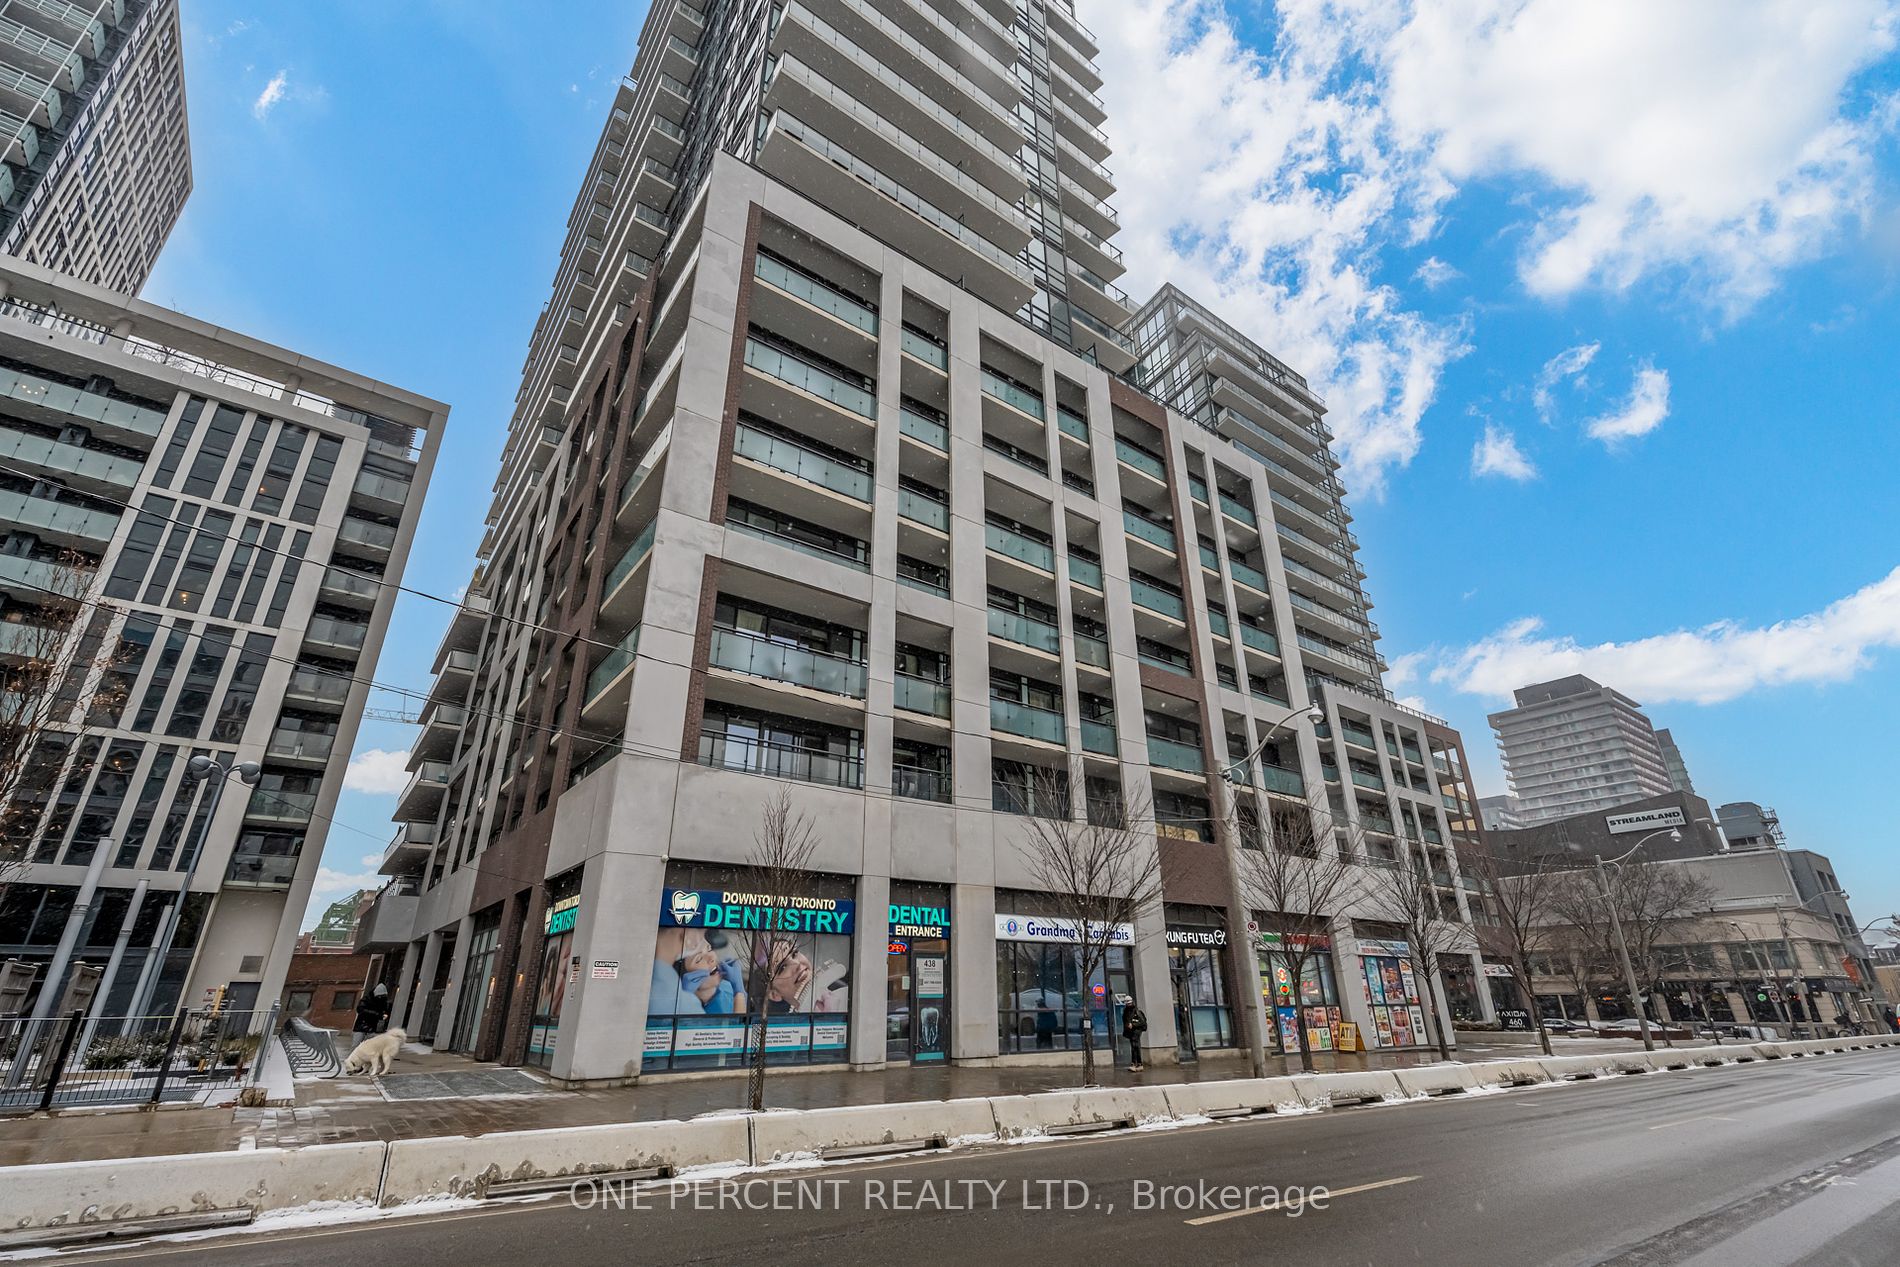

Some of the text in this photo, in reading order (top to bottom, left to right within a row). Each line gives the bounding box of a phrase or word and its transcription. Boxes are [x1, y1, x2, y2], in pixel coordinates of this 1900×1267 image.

[1609, 811, 1680, 826] STREAMLAND
[790, 896, 836, 910] TORONTO
[704, 903, 849, 933] DENTISTRY
[888, 904, 951, 926] DENTAL
[895, 925, 942, 938] ENTRANCE
[1187, 932, 1198, 944] FU
[1199, 933, 1215, 945] TEA
[924, 959, 936, 968] 438
[1509, 1018, 1523, 1026] 460
